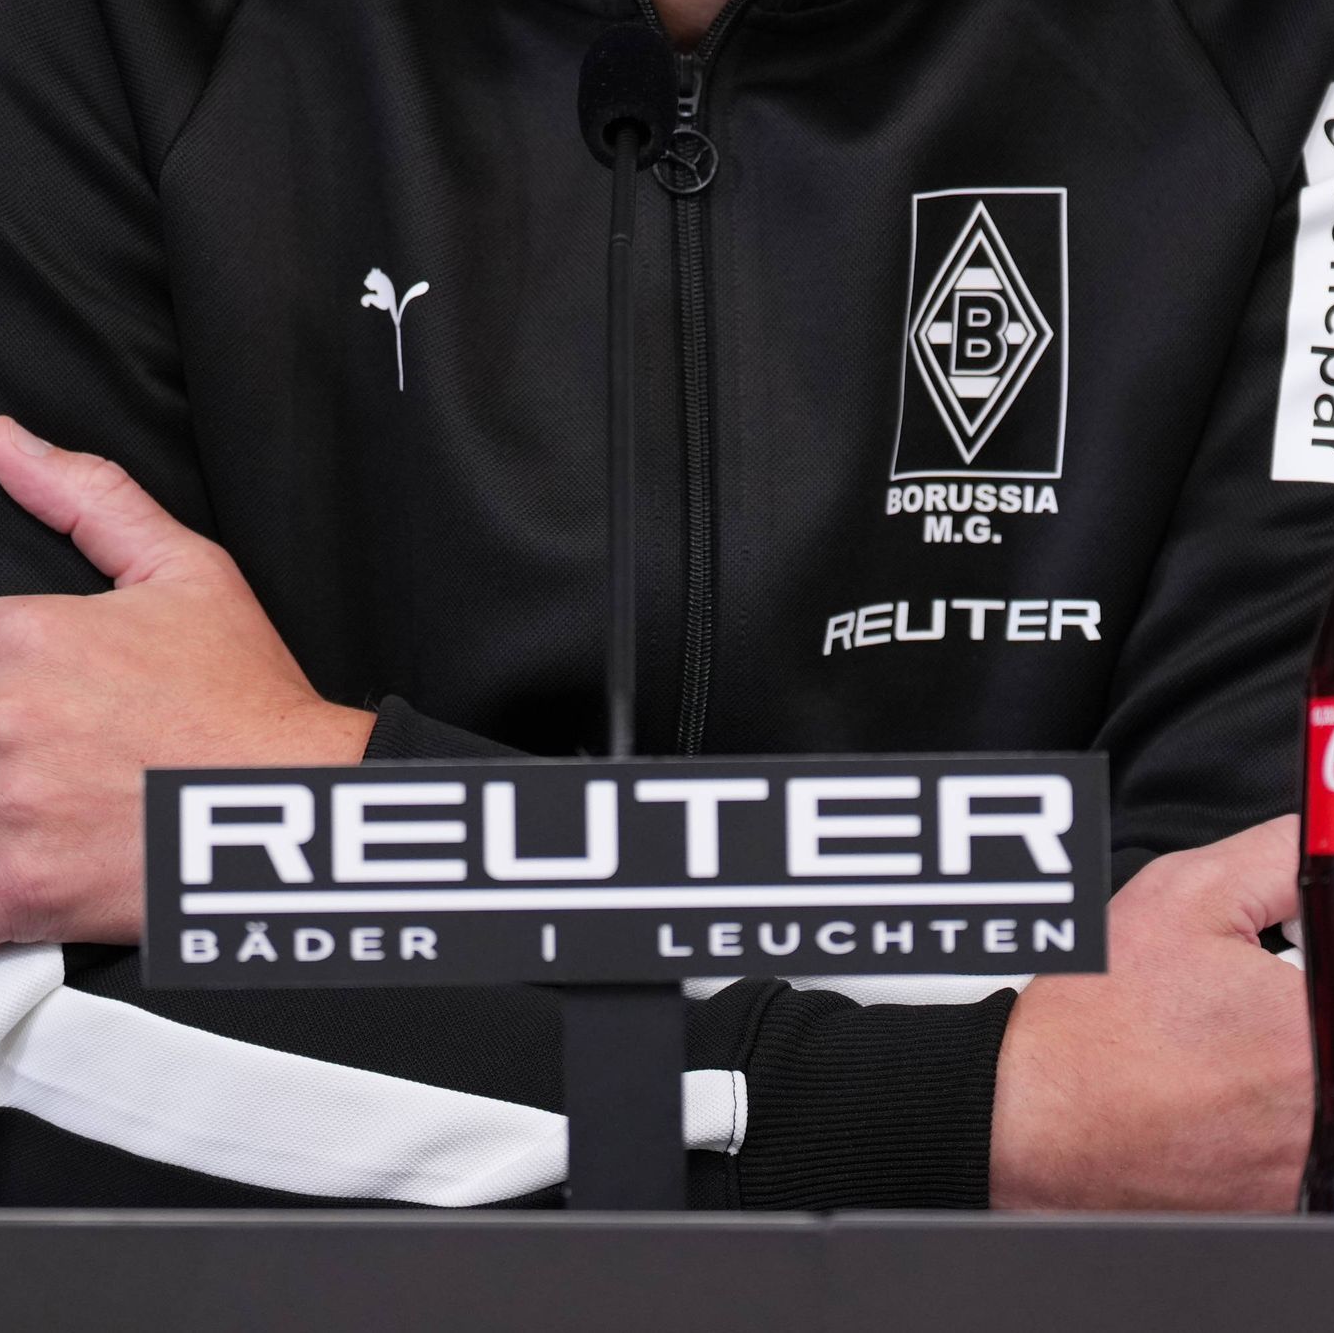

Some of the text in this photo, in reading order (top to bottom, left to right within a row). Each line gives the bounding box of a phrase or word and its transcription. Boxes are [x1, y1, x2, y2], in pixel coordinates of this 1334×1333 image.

[951, 289, 1011, 377] B
[886, 485, 1059, 516] BORUSSIA
[923, 515, 1003, 545] M.G.
[822, 598, 1103, 657] REUTER
[179, 774, 1075, 886] REUTER
[180, 921, 440, 965] BÄDER
[658, 917, 1076, 959] LEUCHTEN
